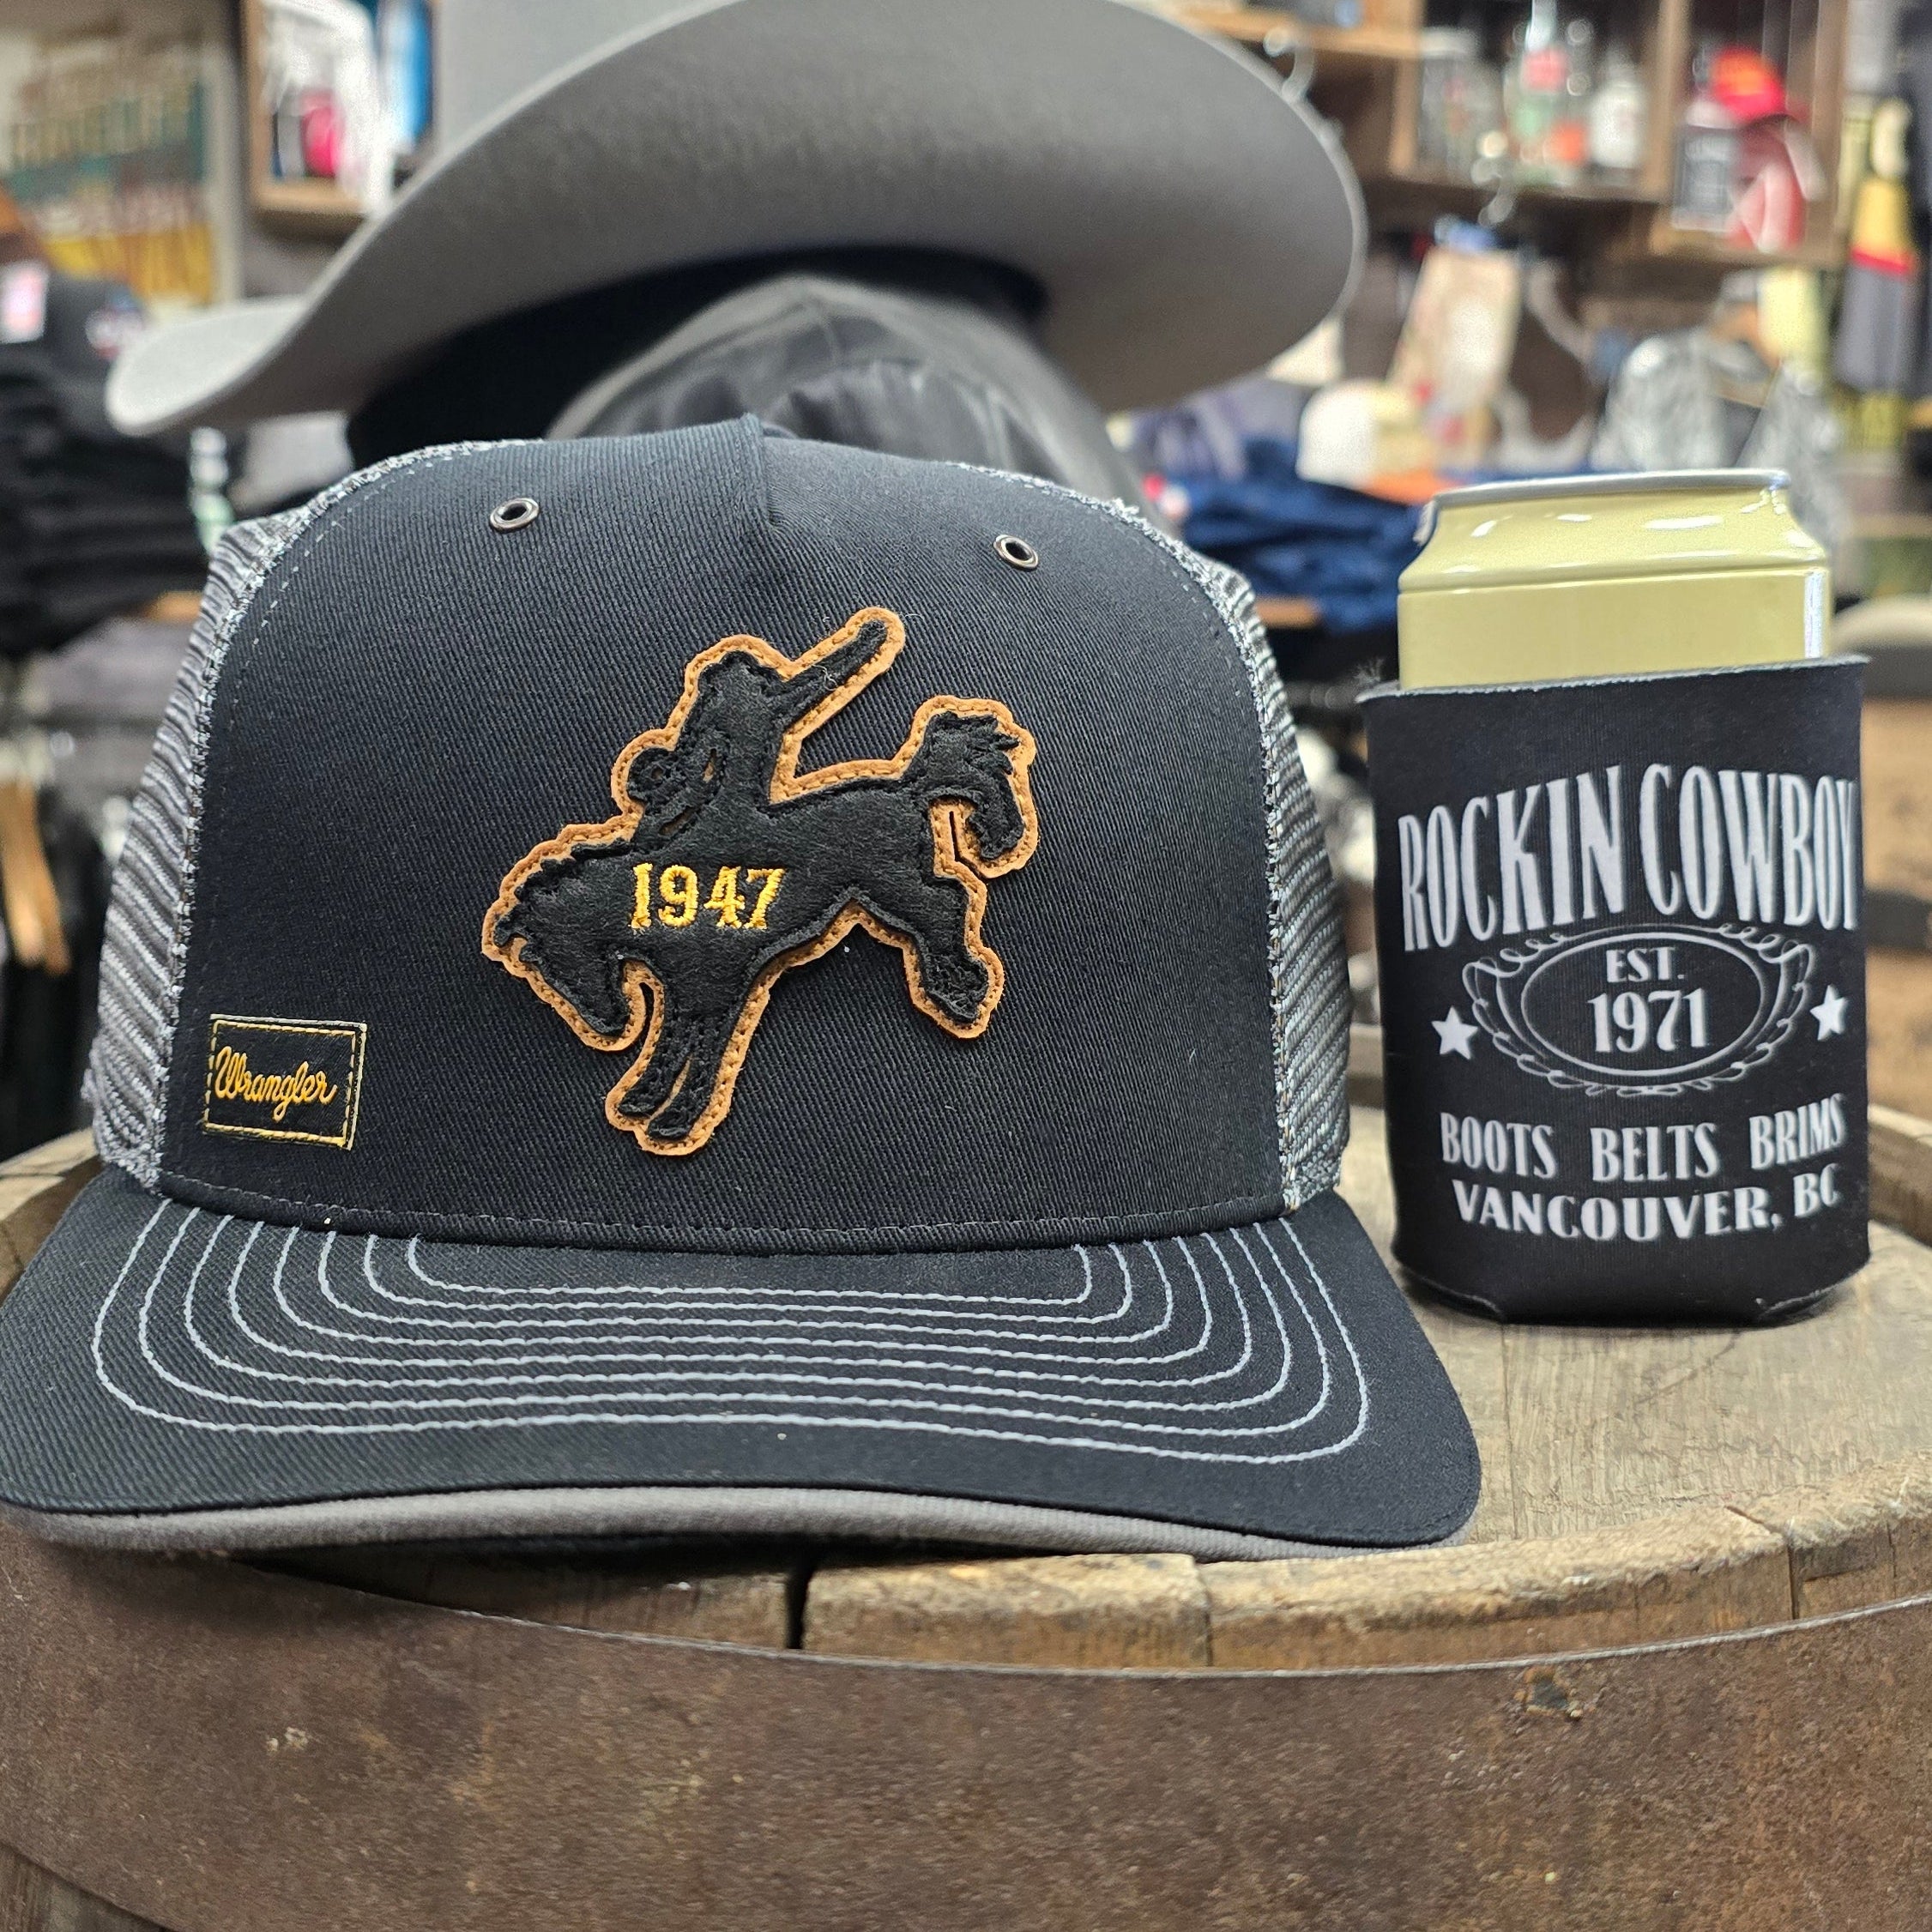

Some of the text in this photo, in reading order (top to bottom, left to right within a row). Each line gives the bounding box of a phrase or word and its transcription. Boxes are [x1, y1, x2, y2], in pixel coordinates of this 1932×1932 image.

[1398, 764, 1857, 952] ROCKIN COWBOY
[630, 862, 785, 930] 1947
[1606, 947, 1685, 983] EST.
[1587, 987, 1707, 1054] 1971
[214, 1045, 338, 1122] Wrangler
[1440, 1093, 1844, 1182] BOOTS BELTS BRIMS
[1793, 1163, 1841, 1218] BC
